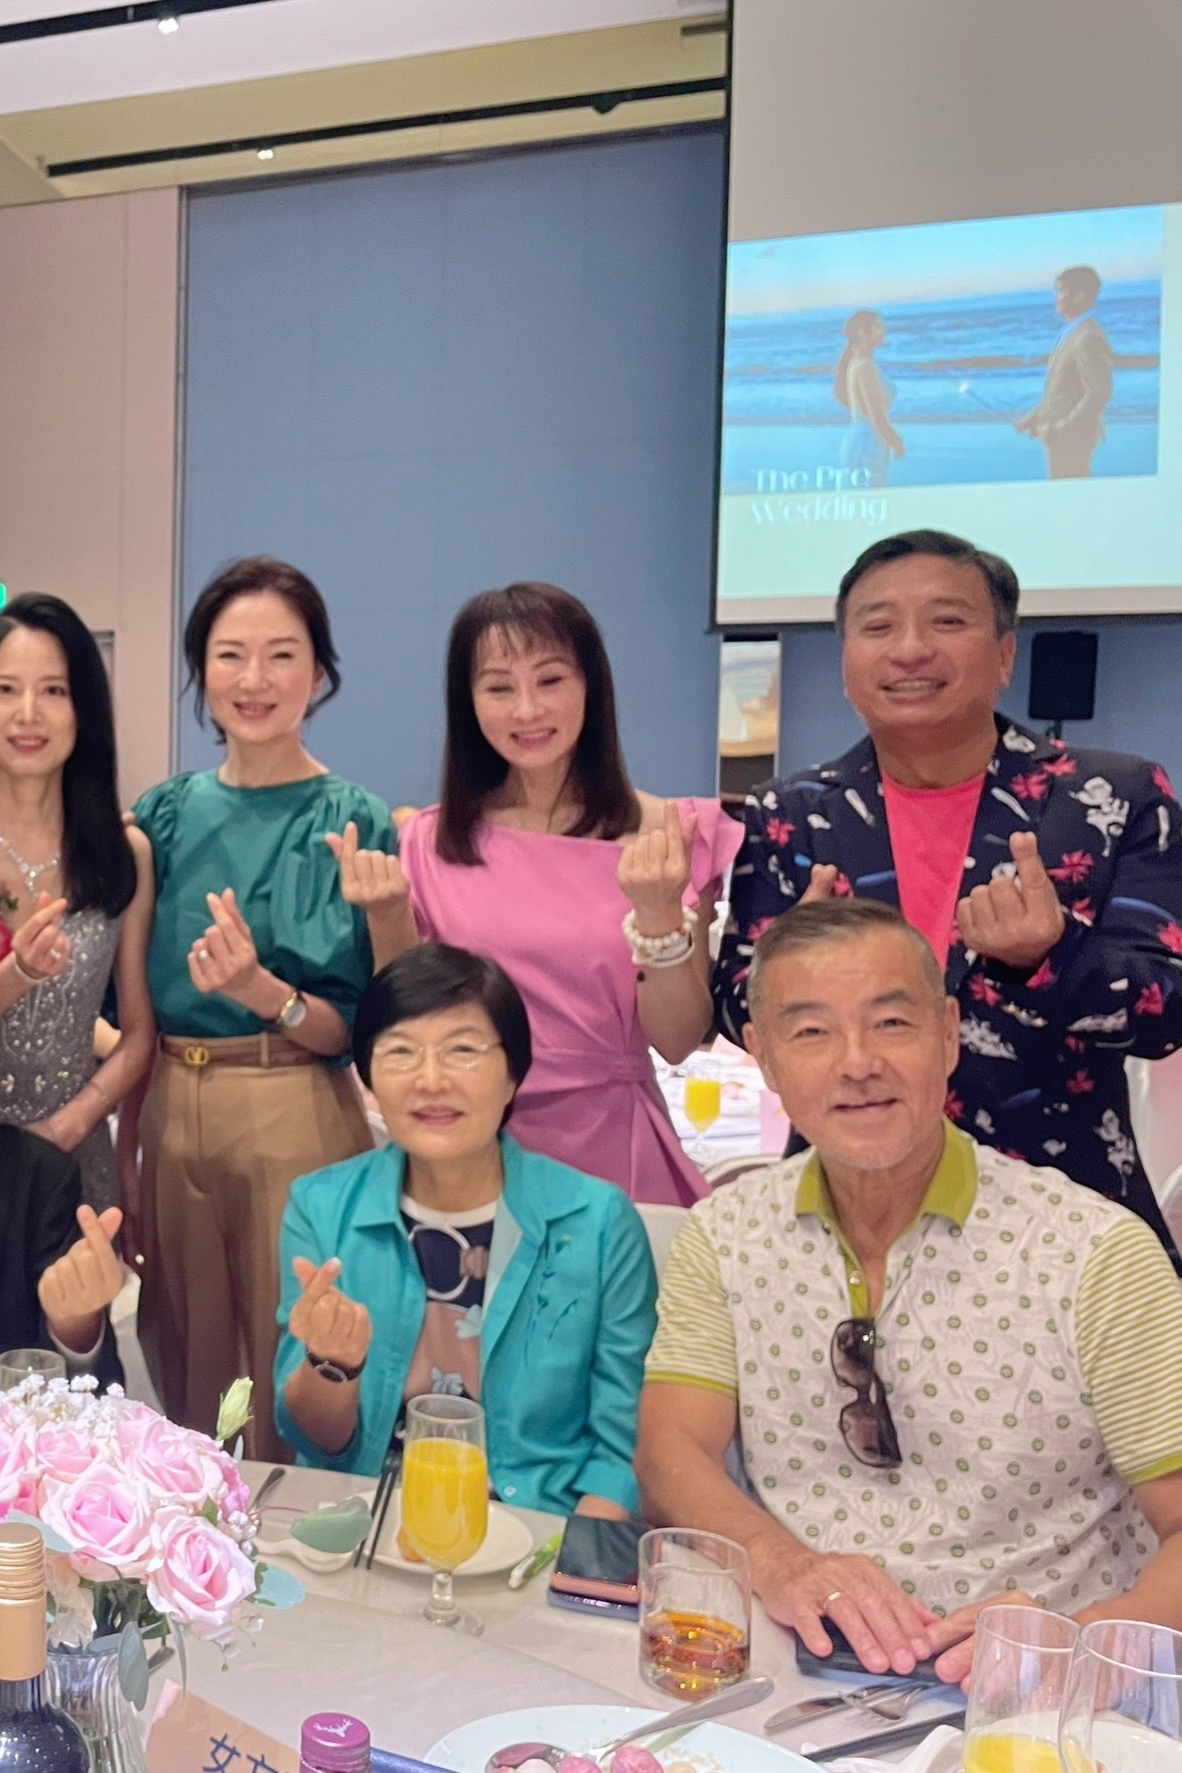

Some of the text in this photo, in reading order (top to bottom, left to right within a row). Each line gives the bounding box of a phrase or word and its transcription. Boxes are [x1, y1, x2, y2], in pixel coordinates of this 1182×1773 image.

[751, 465, 872, 494] The Pre
[751, 496, 888, 526] Wedding
